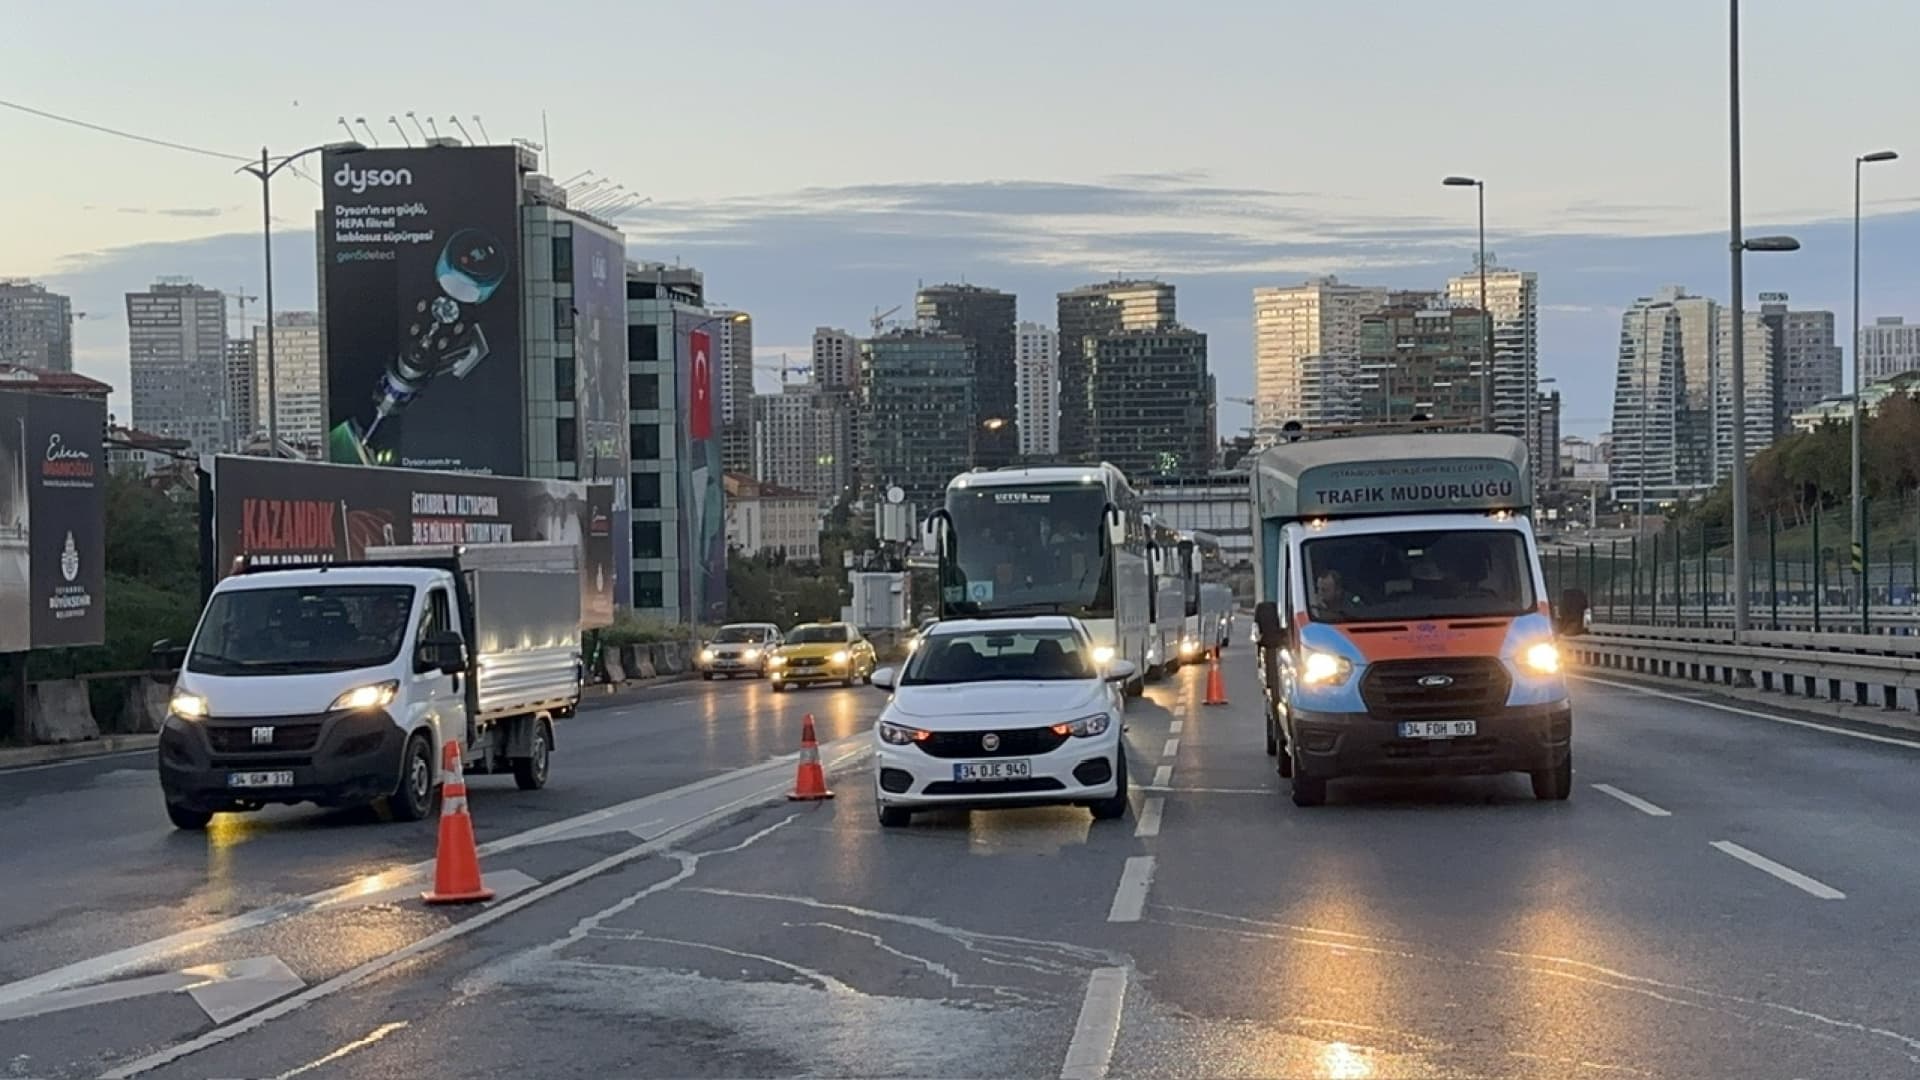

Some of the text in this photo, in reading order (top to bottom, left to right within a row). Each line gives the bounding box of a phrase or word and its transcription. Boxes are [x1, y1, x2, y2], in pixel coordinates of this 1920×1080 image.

[334, 163, 412, 193] dyson
[381, 206, 396, 215] en
[335, 218, 364, 229] HEPA
[1316, 480, 1512, 505] TRAFİK MÜDÜRLÜĞÜ
[243, 499, 336, 549] KAZANDIK
[252, 726, 275, 744] FIAT
[963, 765, 977, 778] 34
[1006, 763, 1028, 776] 940
